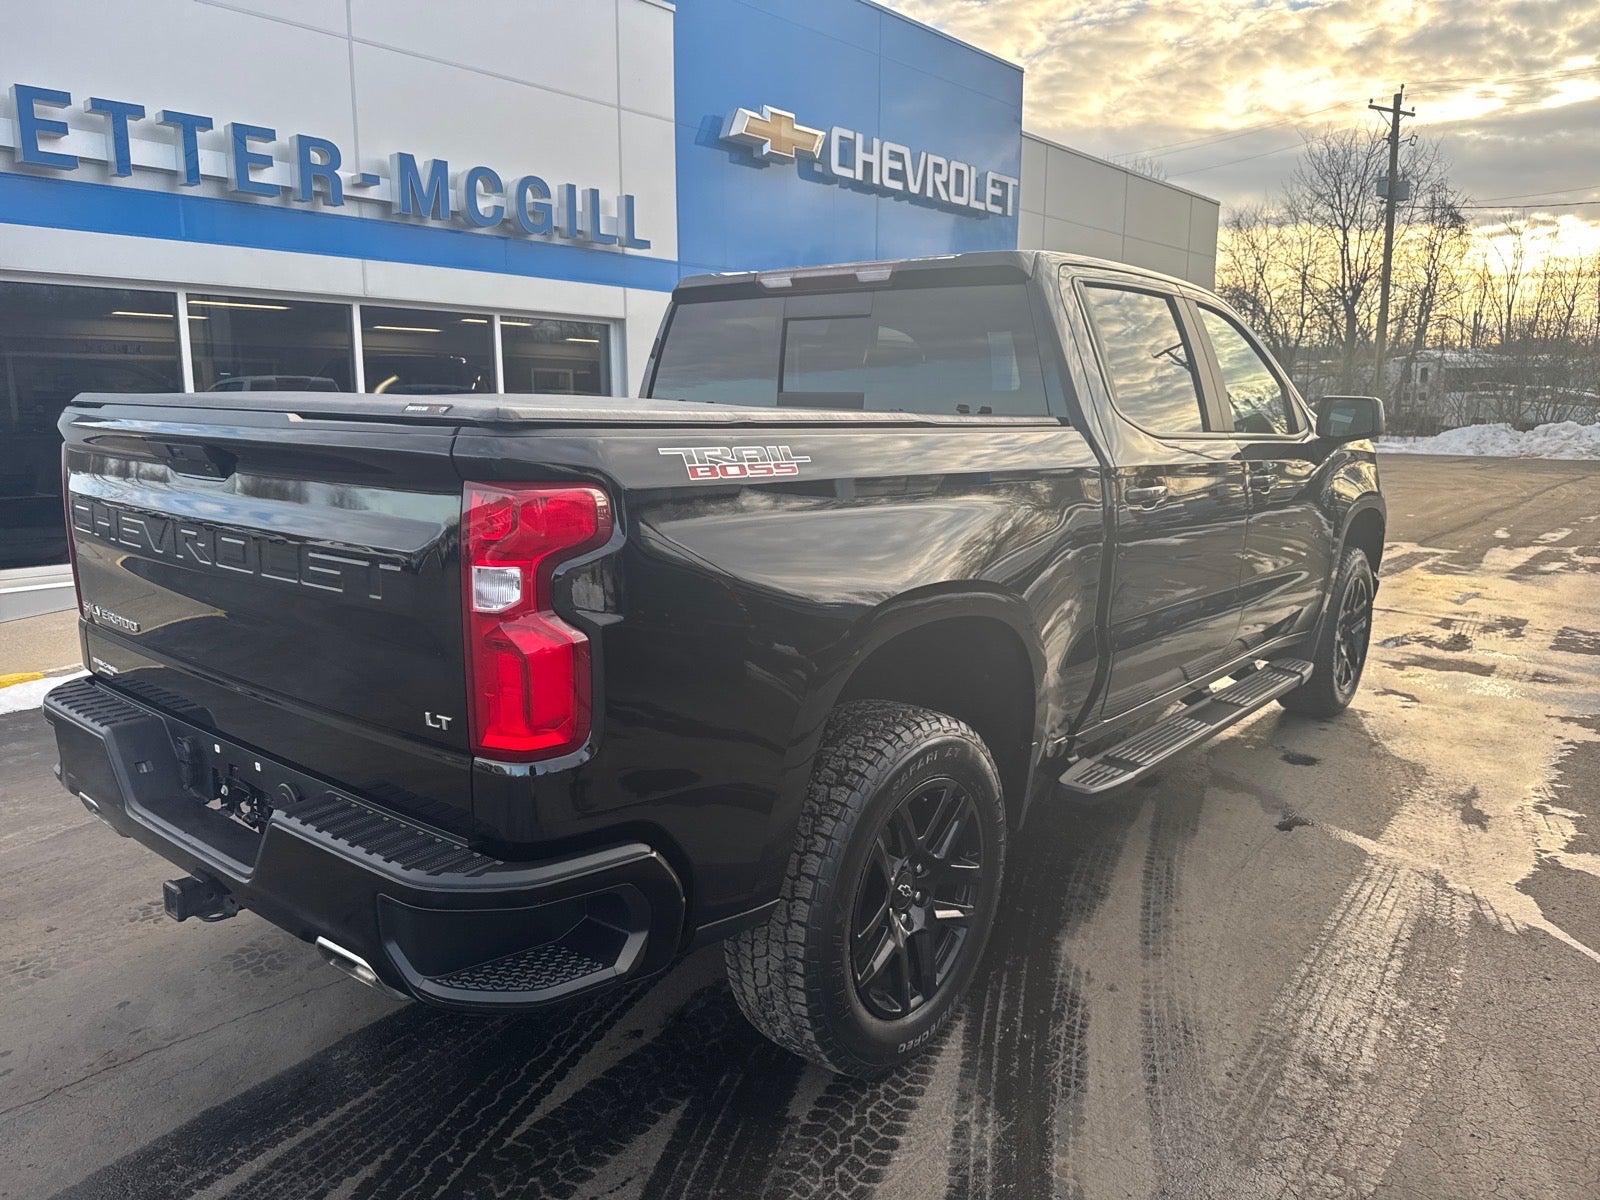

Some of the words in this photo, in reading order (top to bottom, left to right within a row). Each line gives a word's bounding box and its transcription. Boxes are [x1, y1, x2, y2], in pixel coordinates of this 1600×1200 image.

[10, 83, 651, 249] ETTER-MCGILL
[831, 126, 1018, 216] CHEVROLET
[658, 446, 811, 466] TRAIL
[687, 462, 798, 480] BOSS
[73, 502, 402, 599] CHEVROLET
[425, 711, 452, 730] LT
[892, 750, 938, 792] SAFARI
